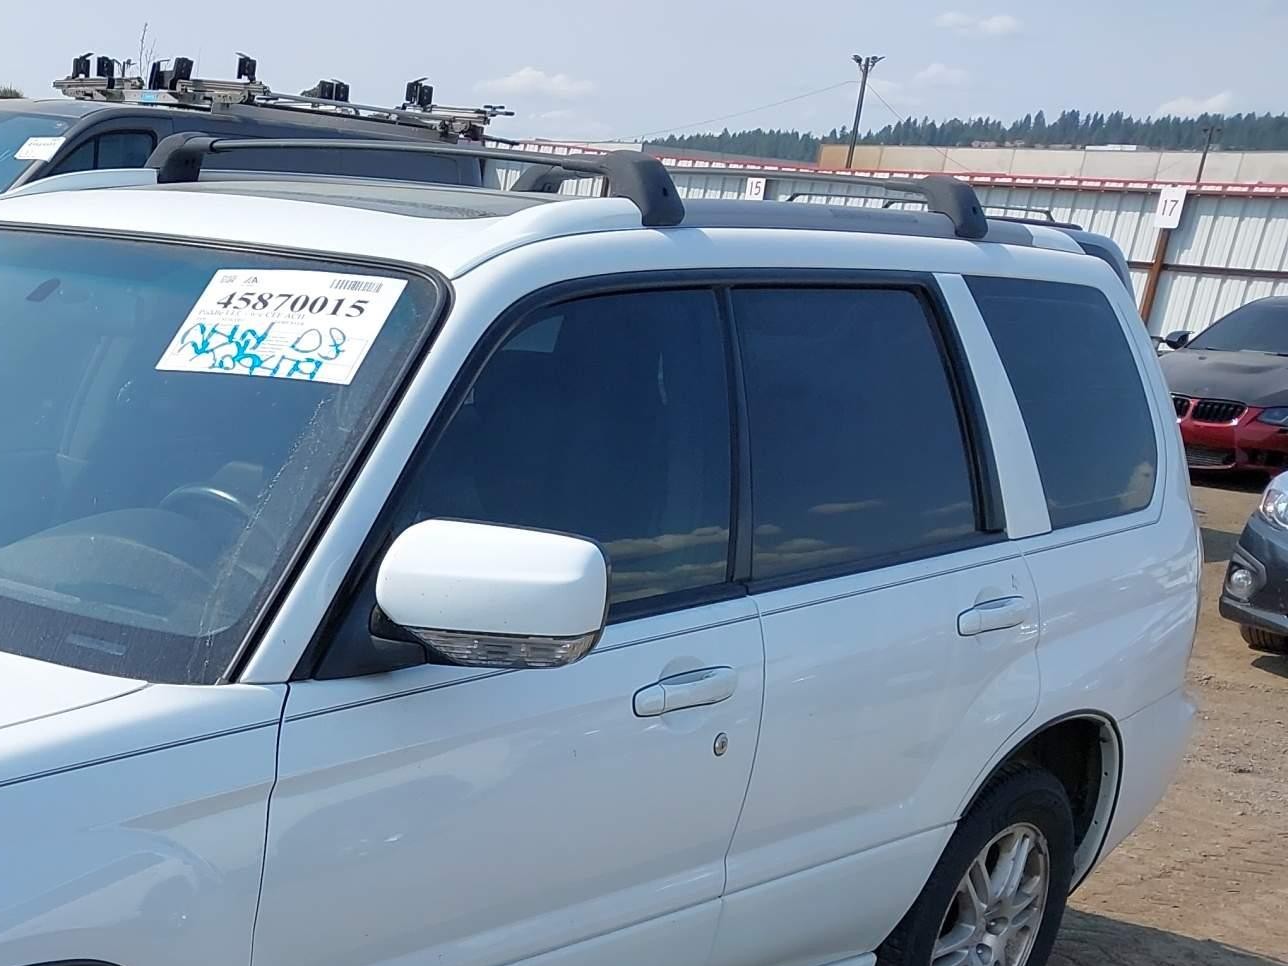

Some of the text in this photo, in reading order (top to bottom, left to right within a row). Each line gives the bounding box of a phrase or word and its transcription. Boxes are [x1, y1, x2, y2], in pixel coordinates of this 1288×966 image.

[749, 180, 762, 196] 15
[1161, 199, 1180, 217] 17
[216, 291, 370, 318] 45870015
